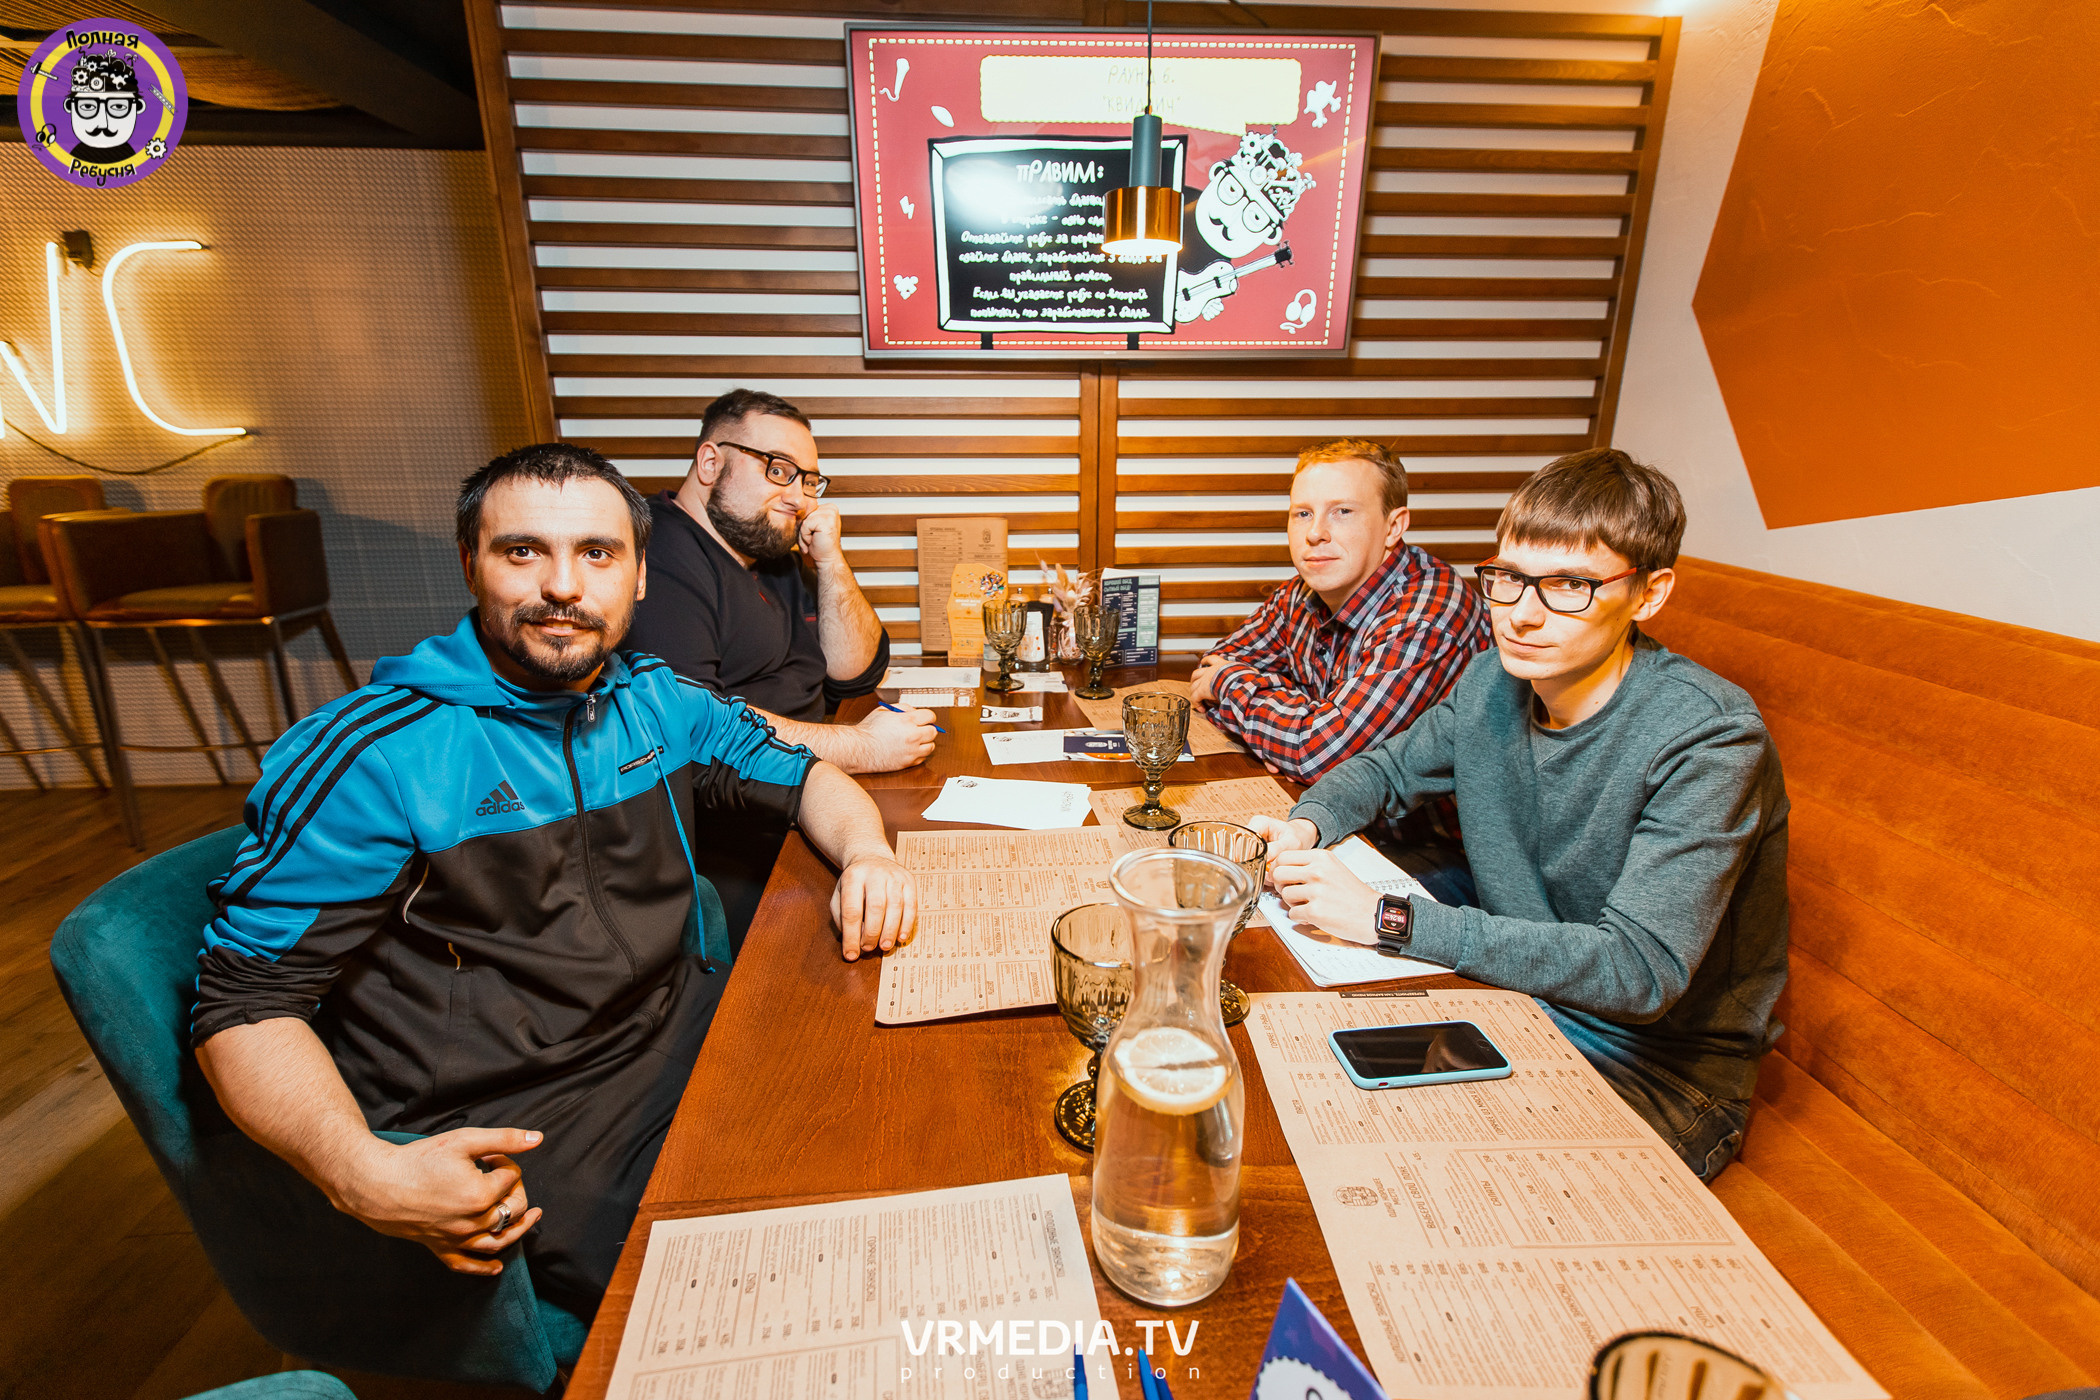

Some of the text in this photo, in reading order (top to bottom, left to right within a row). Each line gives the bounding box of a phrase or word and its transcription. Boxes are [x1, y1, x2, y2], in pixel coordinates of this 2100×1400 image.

[1055, 233, 1069, 244] за
[973, 286, 999, 301] Если
[1022, 308, 1039, 318] то
[475, 800, 526, 817] adidas
[1404, 1183, 1422, 1199] СВОЙ
[1481, 1180, 1502, 1207] САЛАТЫ
[1416, 1201, 1436, 1229] ВЫБЕРИ
[866, 1236, 877, 1302] ГОРЯЧИЕ ЗАКУСКИ
[745, 1272, 757, 1294] СУПЫ
